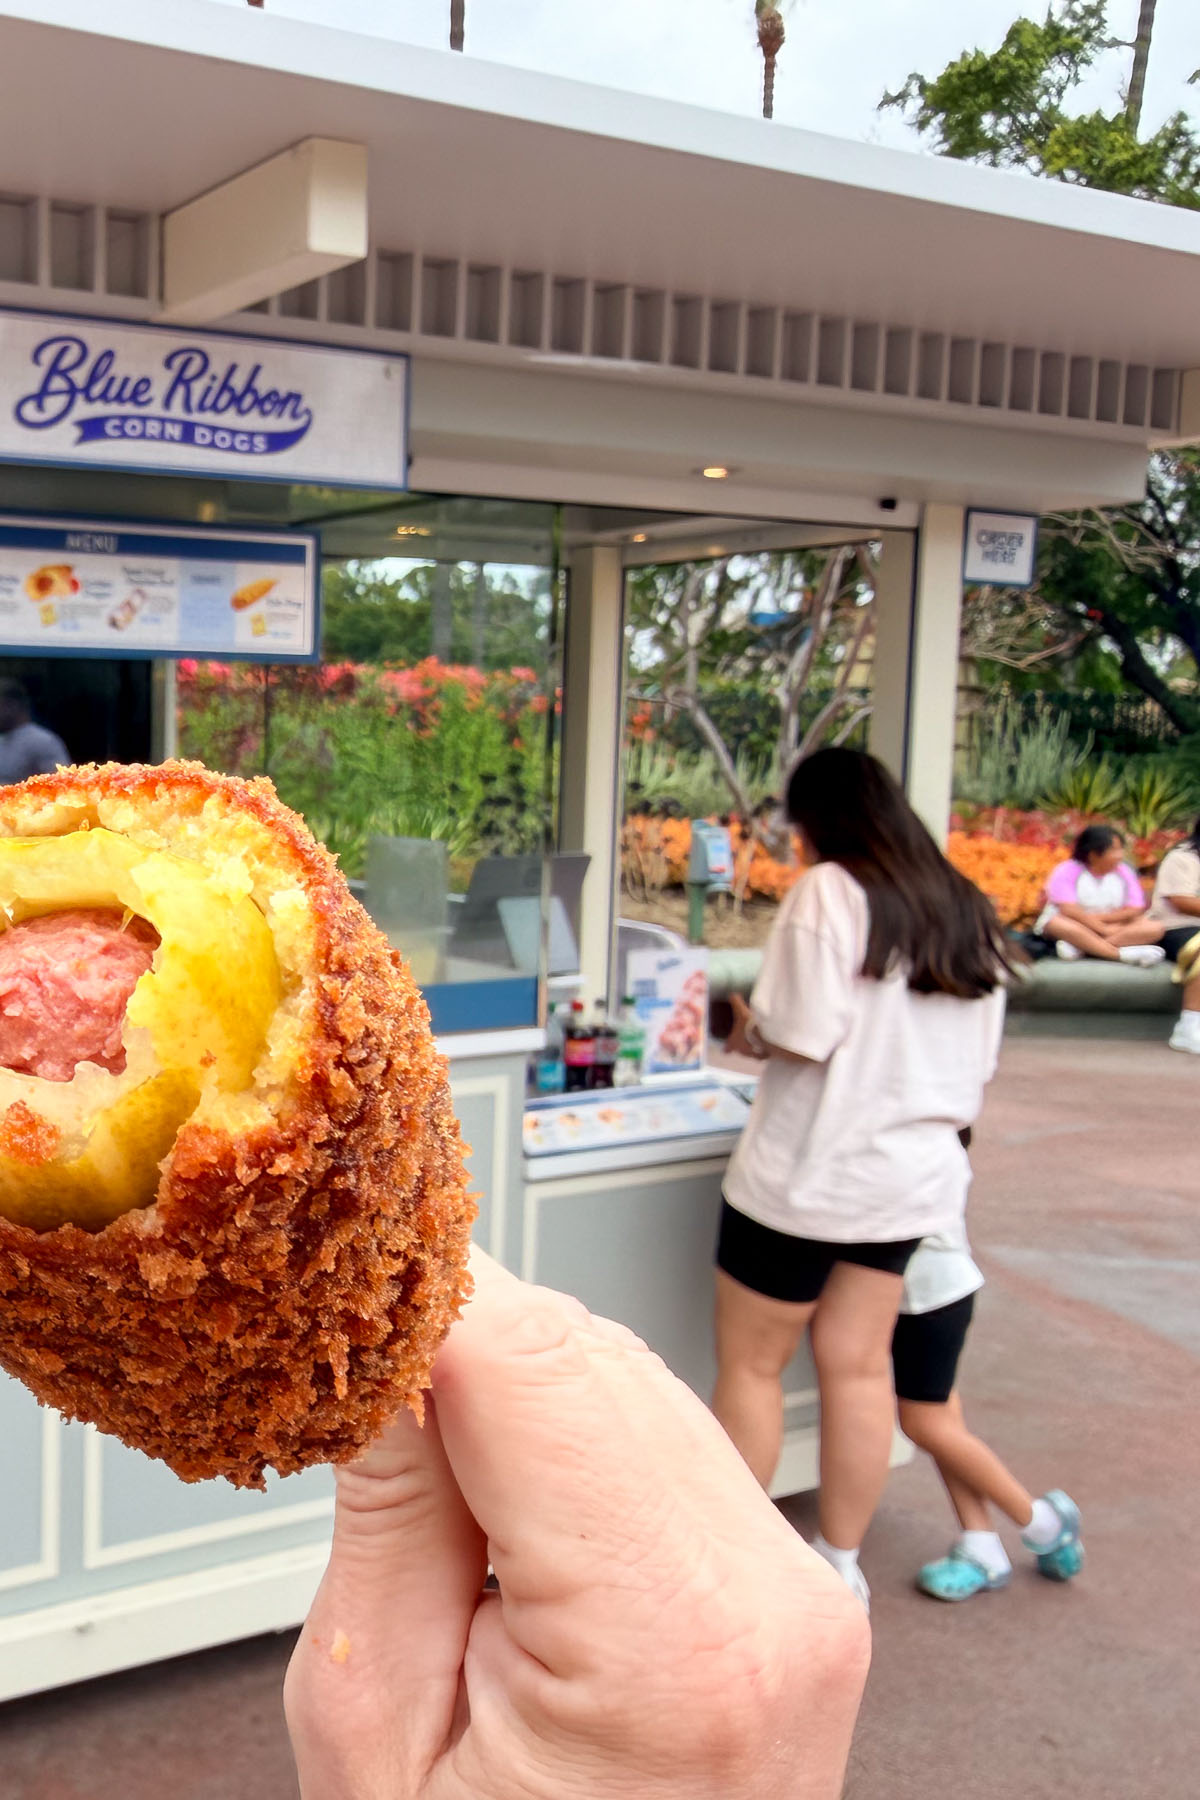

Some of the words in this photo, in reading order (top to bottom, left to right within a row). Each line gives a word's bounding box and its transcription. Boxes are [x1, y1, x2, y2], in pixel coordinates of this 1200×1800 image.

[13, 335, 153, 429] Blue
[163, 347, 312, 425] Ribbon
[104, 418, 181, 442] CORN
[194, 428, 269, 454] DOGS
[65, 533, 118, 553] MENU
